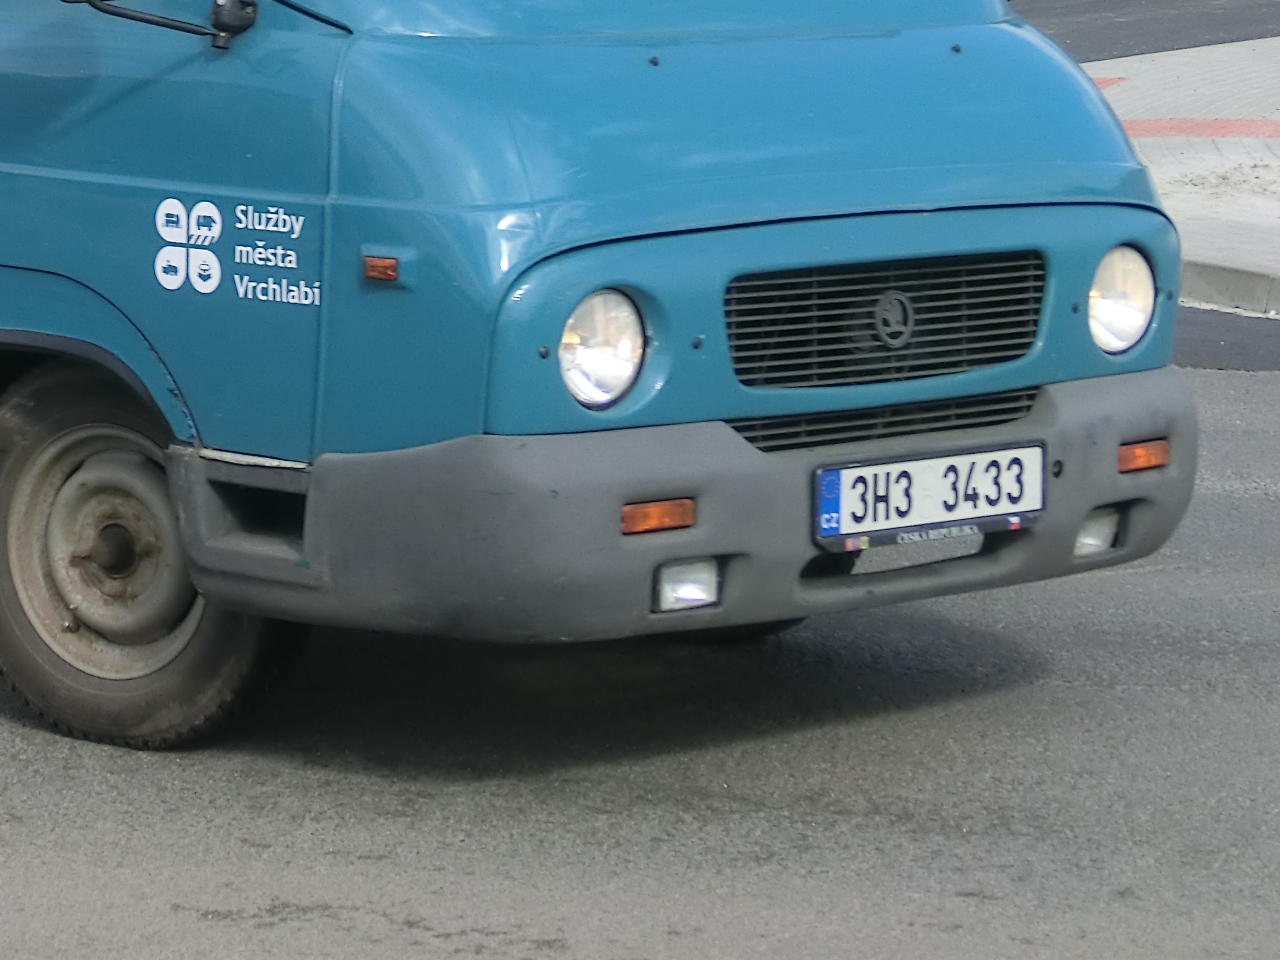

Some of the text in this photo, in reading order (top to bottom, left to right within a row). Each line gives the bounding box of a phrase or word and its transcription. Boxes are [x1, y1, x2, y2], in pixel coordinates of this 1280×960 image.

[234, 204, 305, 239] Služby
[234, 240, 298, 269] města
[233, 273, 321, 307] Vrchlabí
[850, 456, 1025, 524] 3H3 3433
[820, 512, 839, 529] CZ
